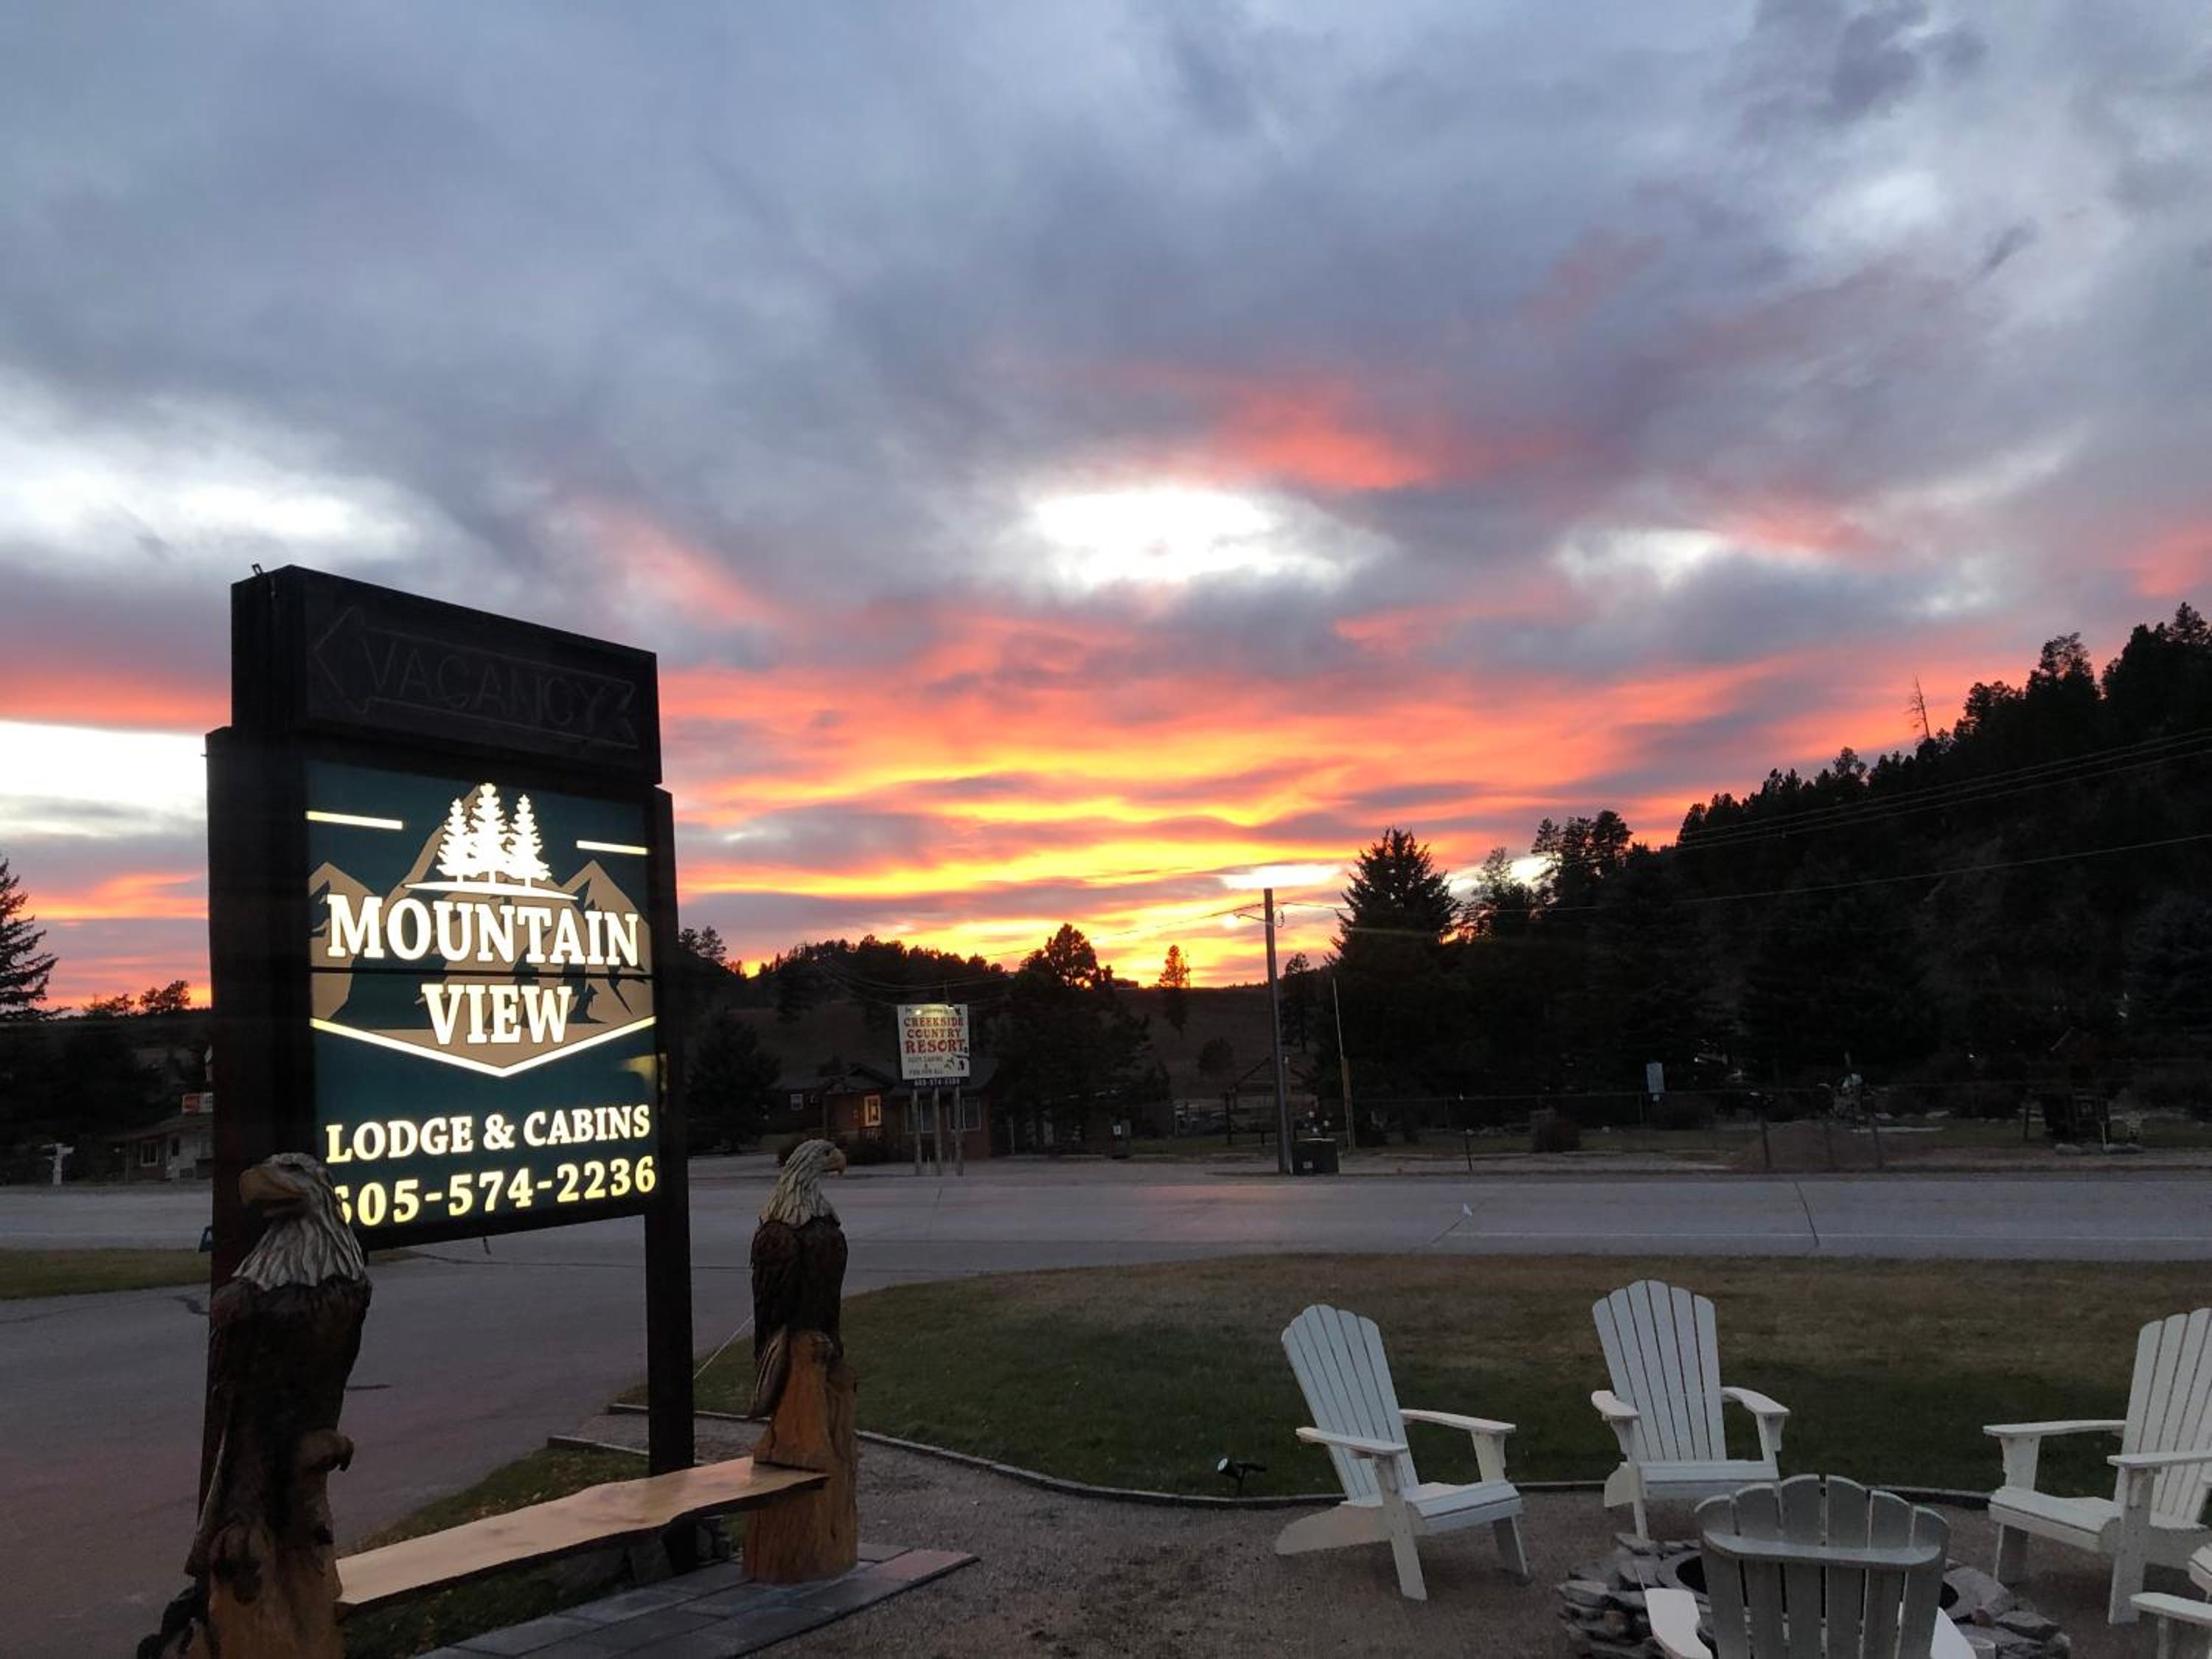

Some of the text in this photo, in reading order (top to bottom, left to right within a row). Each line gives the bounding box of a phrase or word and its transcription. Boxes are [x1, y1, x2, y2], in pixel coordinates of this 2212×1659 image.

[360, 637, 605, 732] VACANCY
[327, 894, 638, 967] MOUNTAIN
[422, 984, 572, 1045] VIEW
[904, 1017, 964, 1027] CREEKSIDE
[907, 1029, 961, 1038] COUNTRY
[905, 1040, 964, 1054] RESORT
[327, 1105, 650, 1163] LODGE & CABINS
